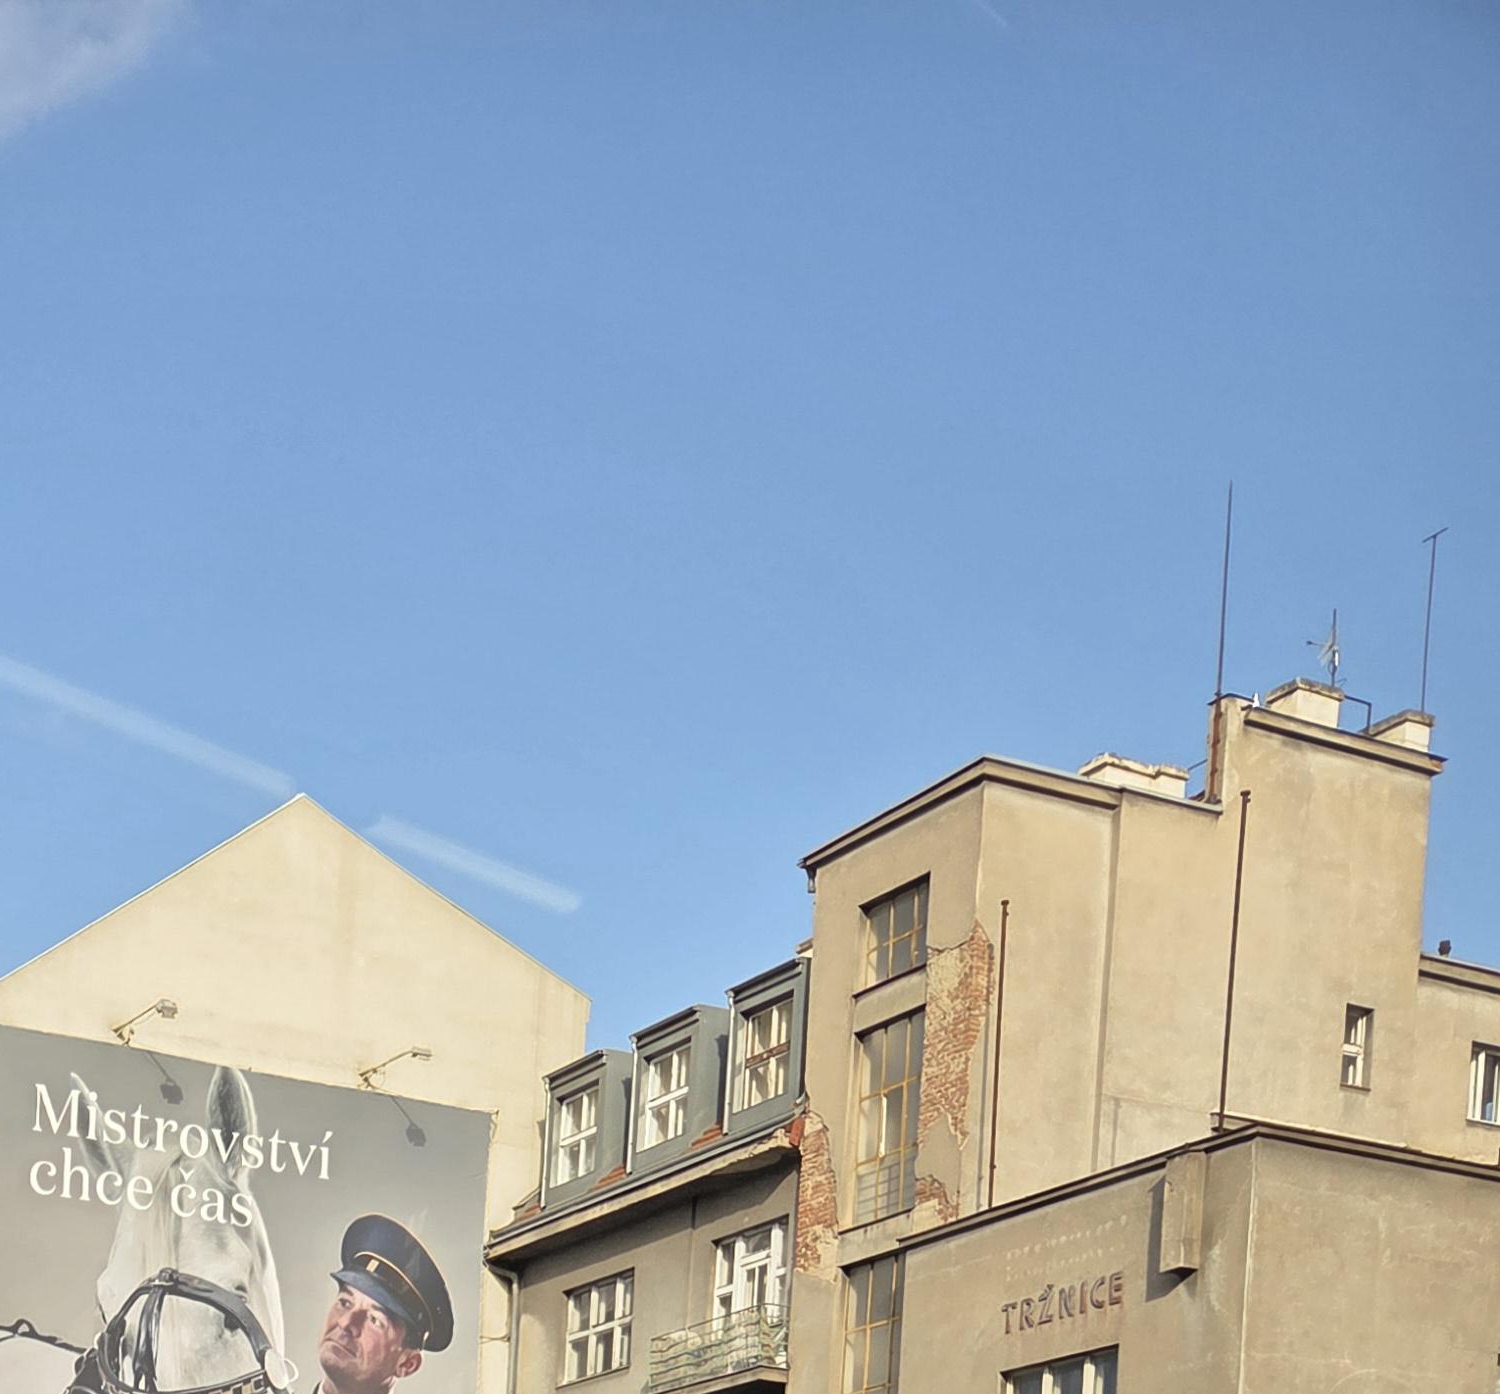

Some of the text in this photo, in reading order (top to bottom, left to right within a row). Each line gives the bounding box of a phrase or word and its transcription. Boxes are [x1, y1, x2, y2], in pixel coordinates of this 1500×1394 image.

[32, 1083, 333, 1180] Mistrovství
[29, 1147, 254, 1227] chce čas
[1001, 1270, 1124, 1335] TRŽNICE
